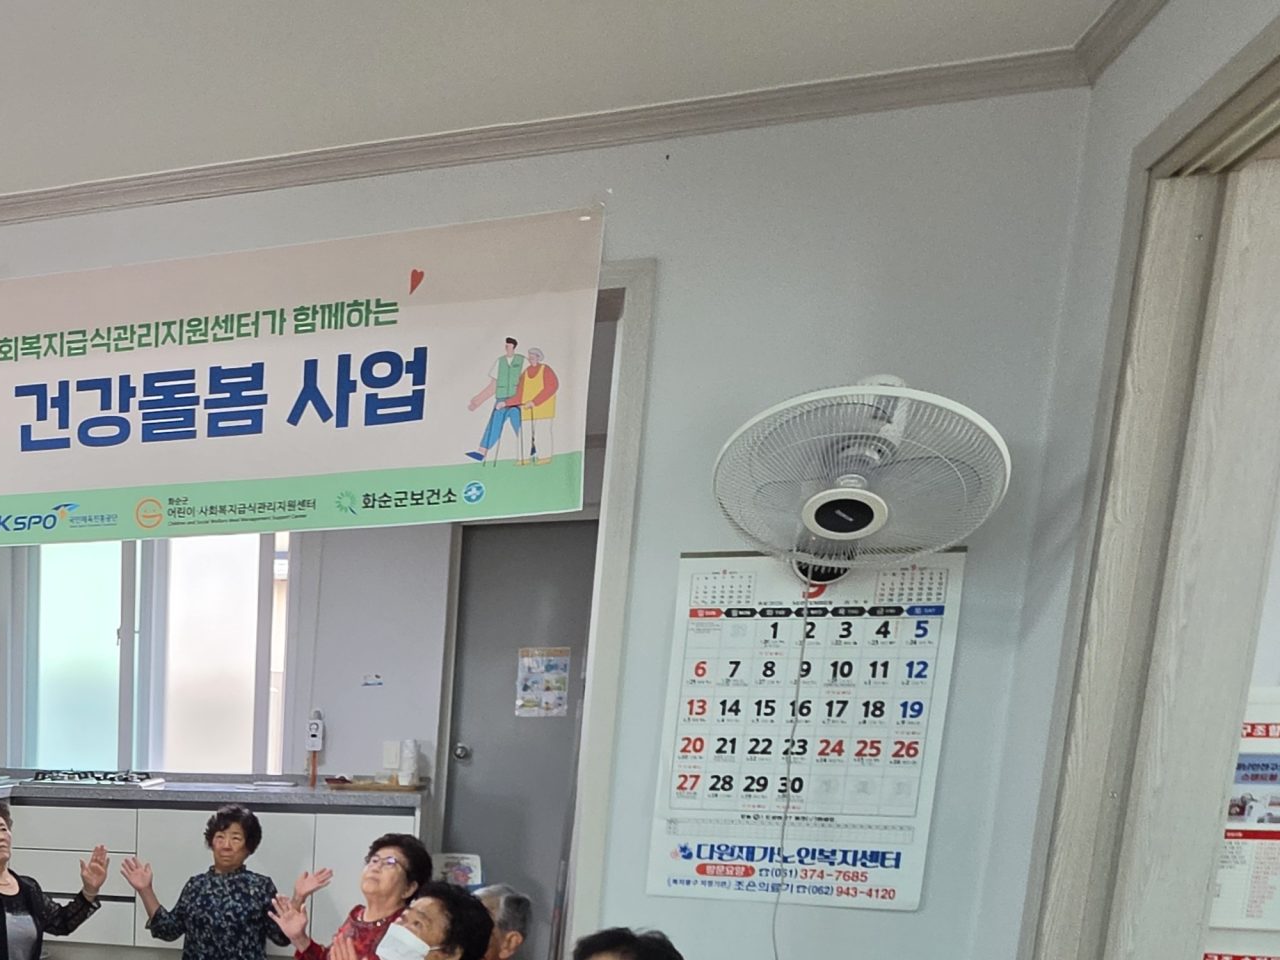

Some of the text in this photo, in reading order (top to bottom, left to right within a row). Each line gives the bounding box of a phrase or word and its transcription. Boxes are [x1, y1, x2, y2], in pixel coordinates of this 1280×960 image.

[293, 297, 399, 335] 함께하는
[14, 361, 269, 453] 건강돌봄
[286, 346, 429, 429] 사업
[361, 486, 458, 511] 화순군보건소
[770, 620, 929, 639] 1 2 3 4 5
[694, 660, 929, 679] 6 7 8 9 10 11 12
[687, 699, 924, 719] 13 14 15 16 17 18 19
[680, 737, 919, 758] 20 21 22 23 24 25 26
[676, 774, 804, 794] 27 28 29 30
[704, 864, 746, 877] 방문요양
[799, 868, 869, 883] 374-7685
[807, 885, 834, 897] (062)
[835, 886, 897, 901] 943-4120
